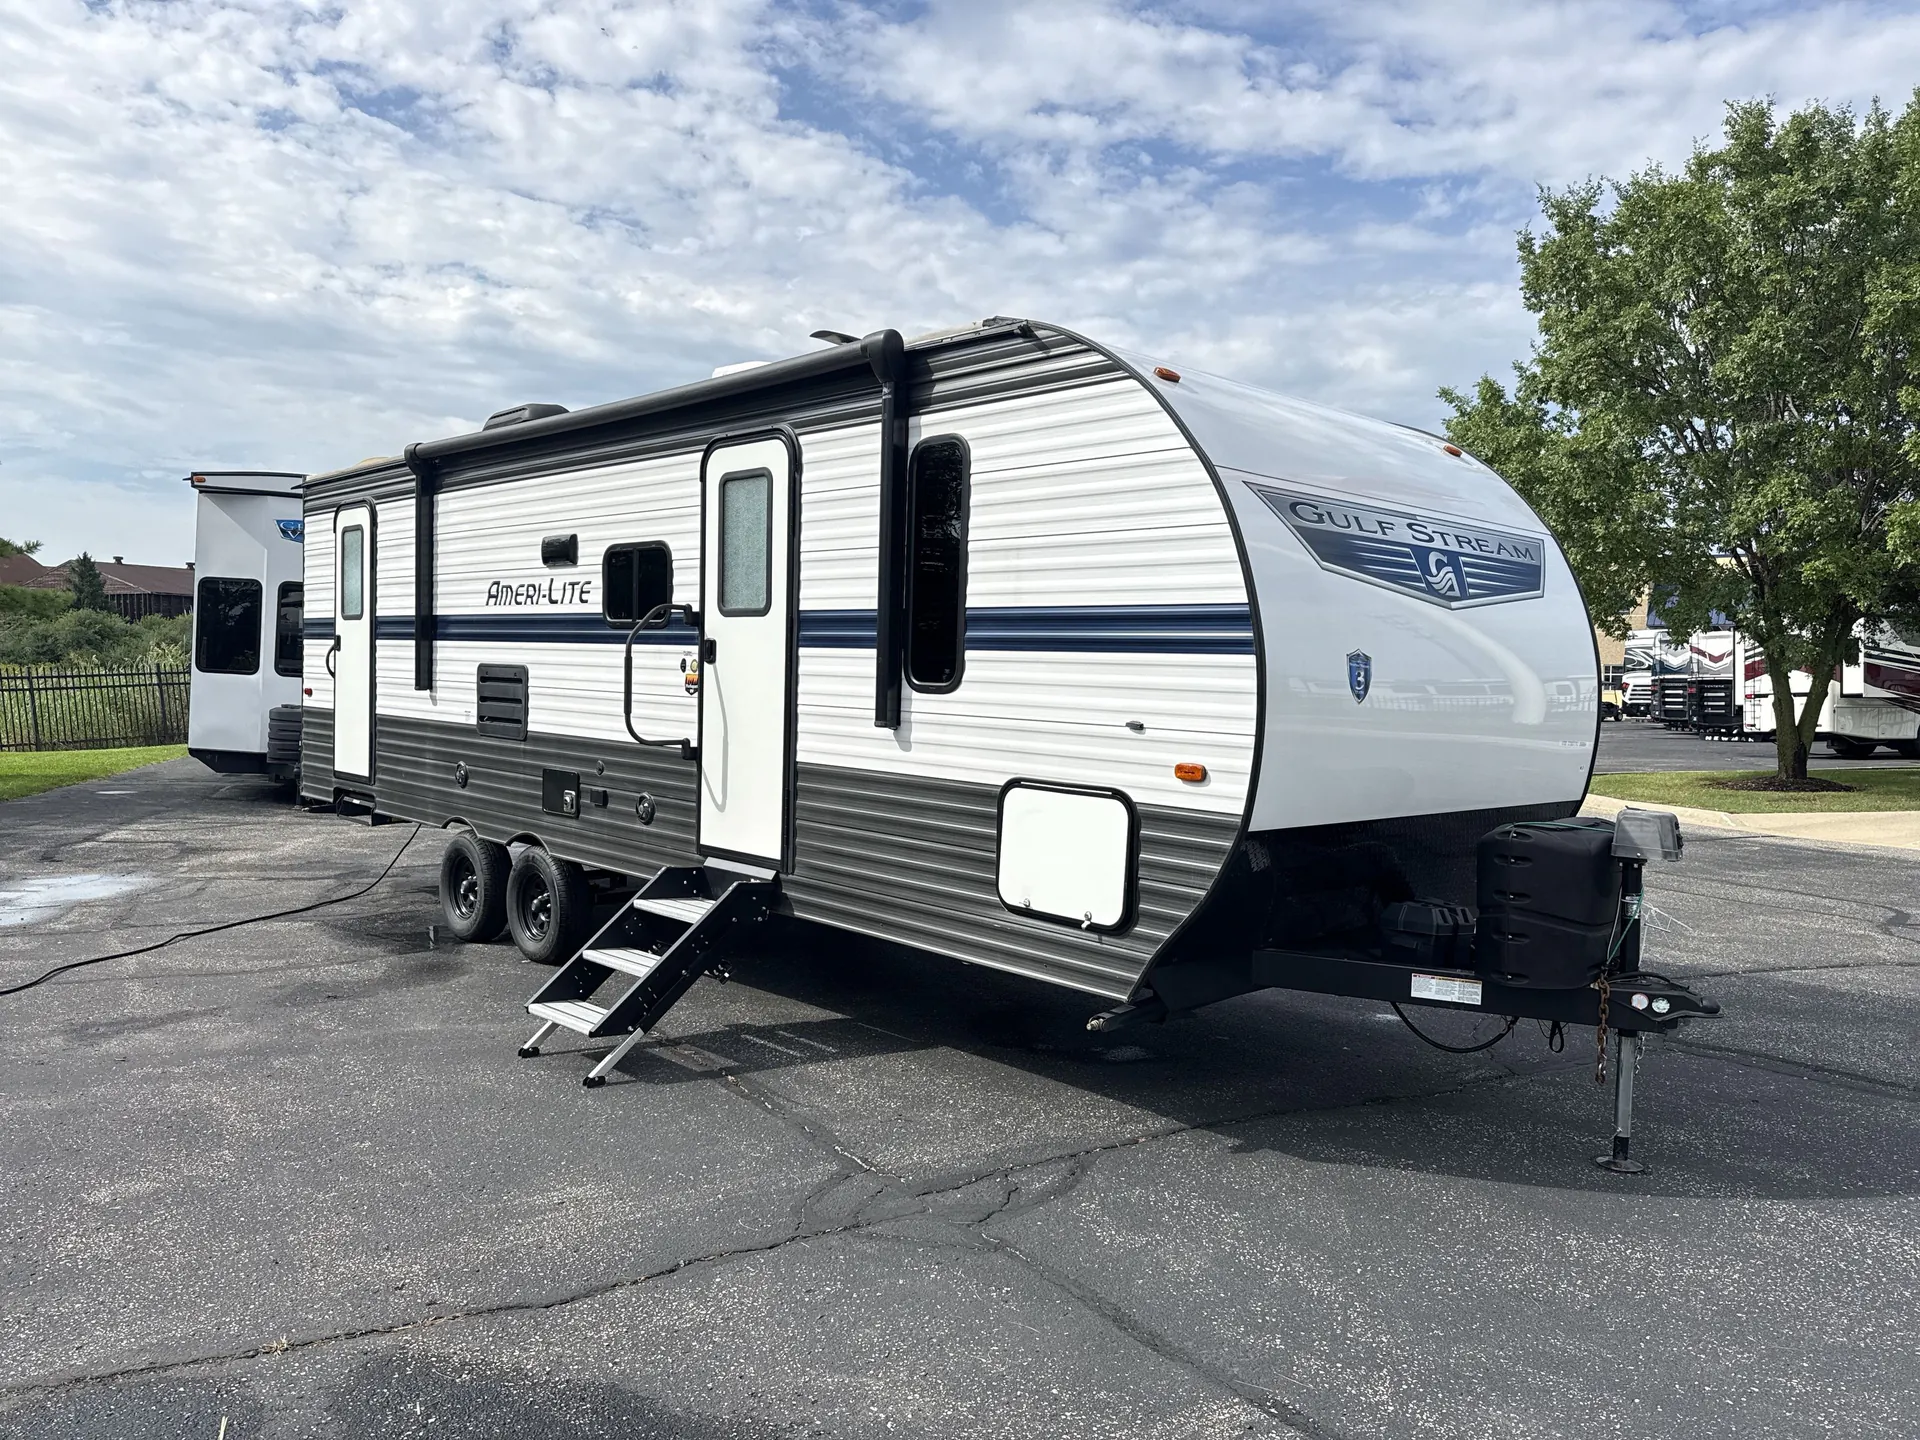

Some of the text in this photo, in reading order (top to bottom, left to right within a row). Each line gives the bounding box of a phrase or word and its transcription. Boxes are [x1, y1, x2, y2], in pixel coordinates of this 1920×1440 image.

[1288, 500, 1536, 562] GULF STREAM
[1355, 670, 1365, 690] 3
